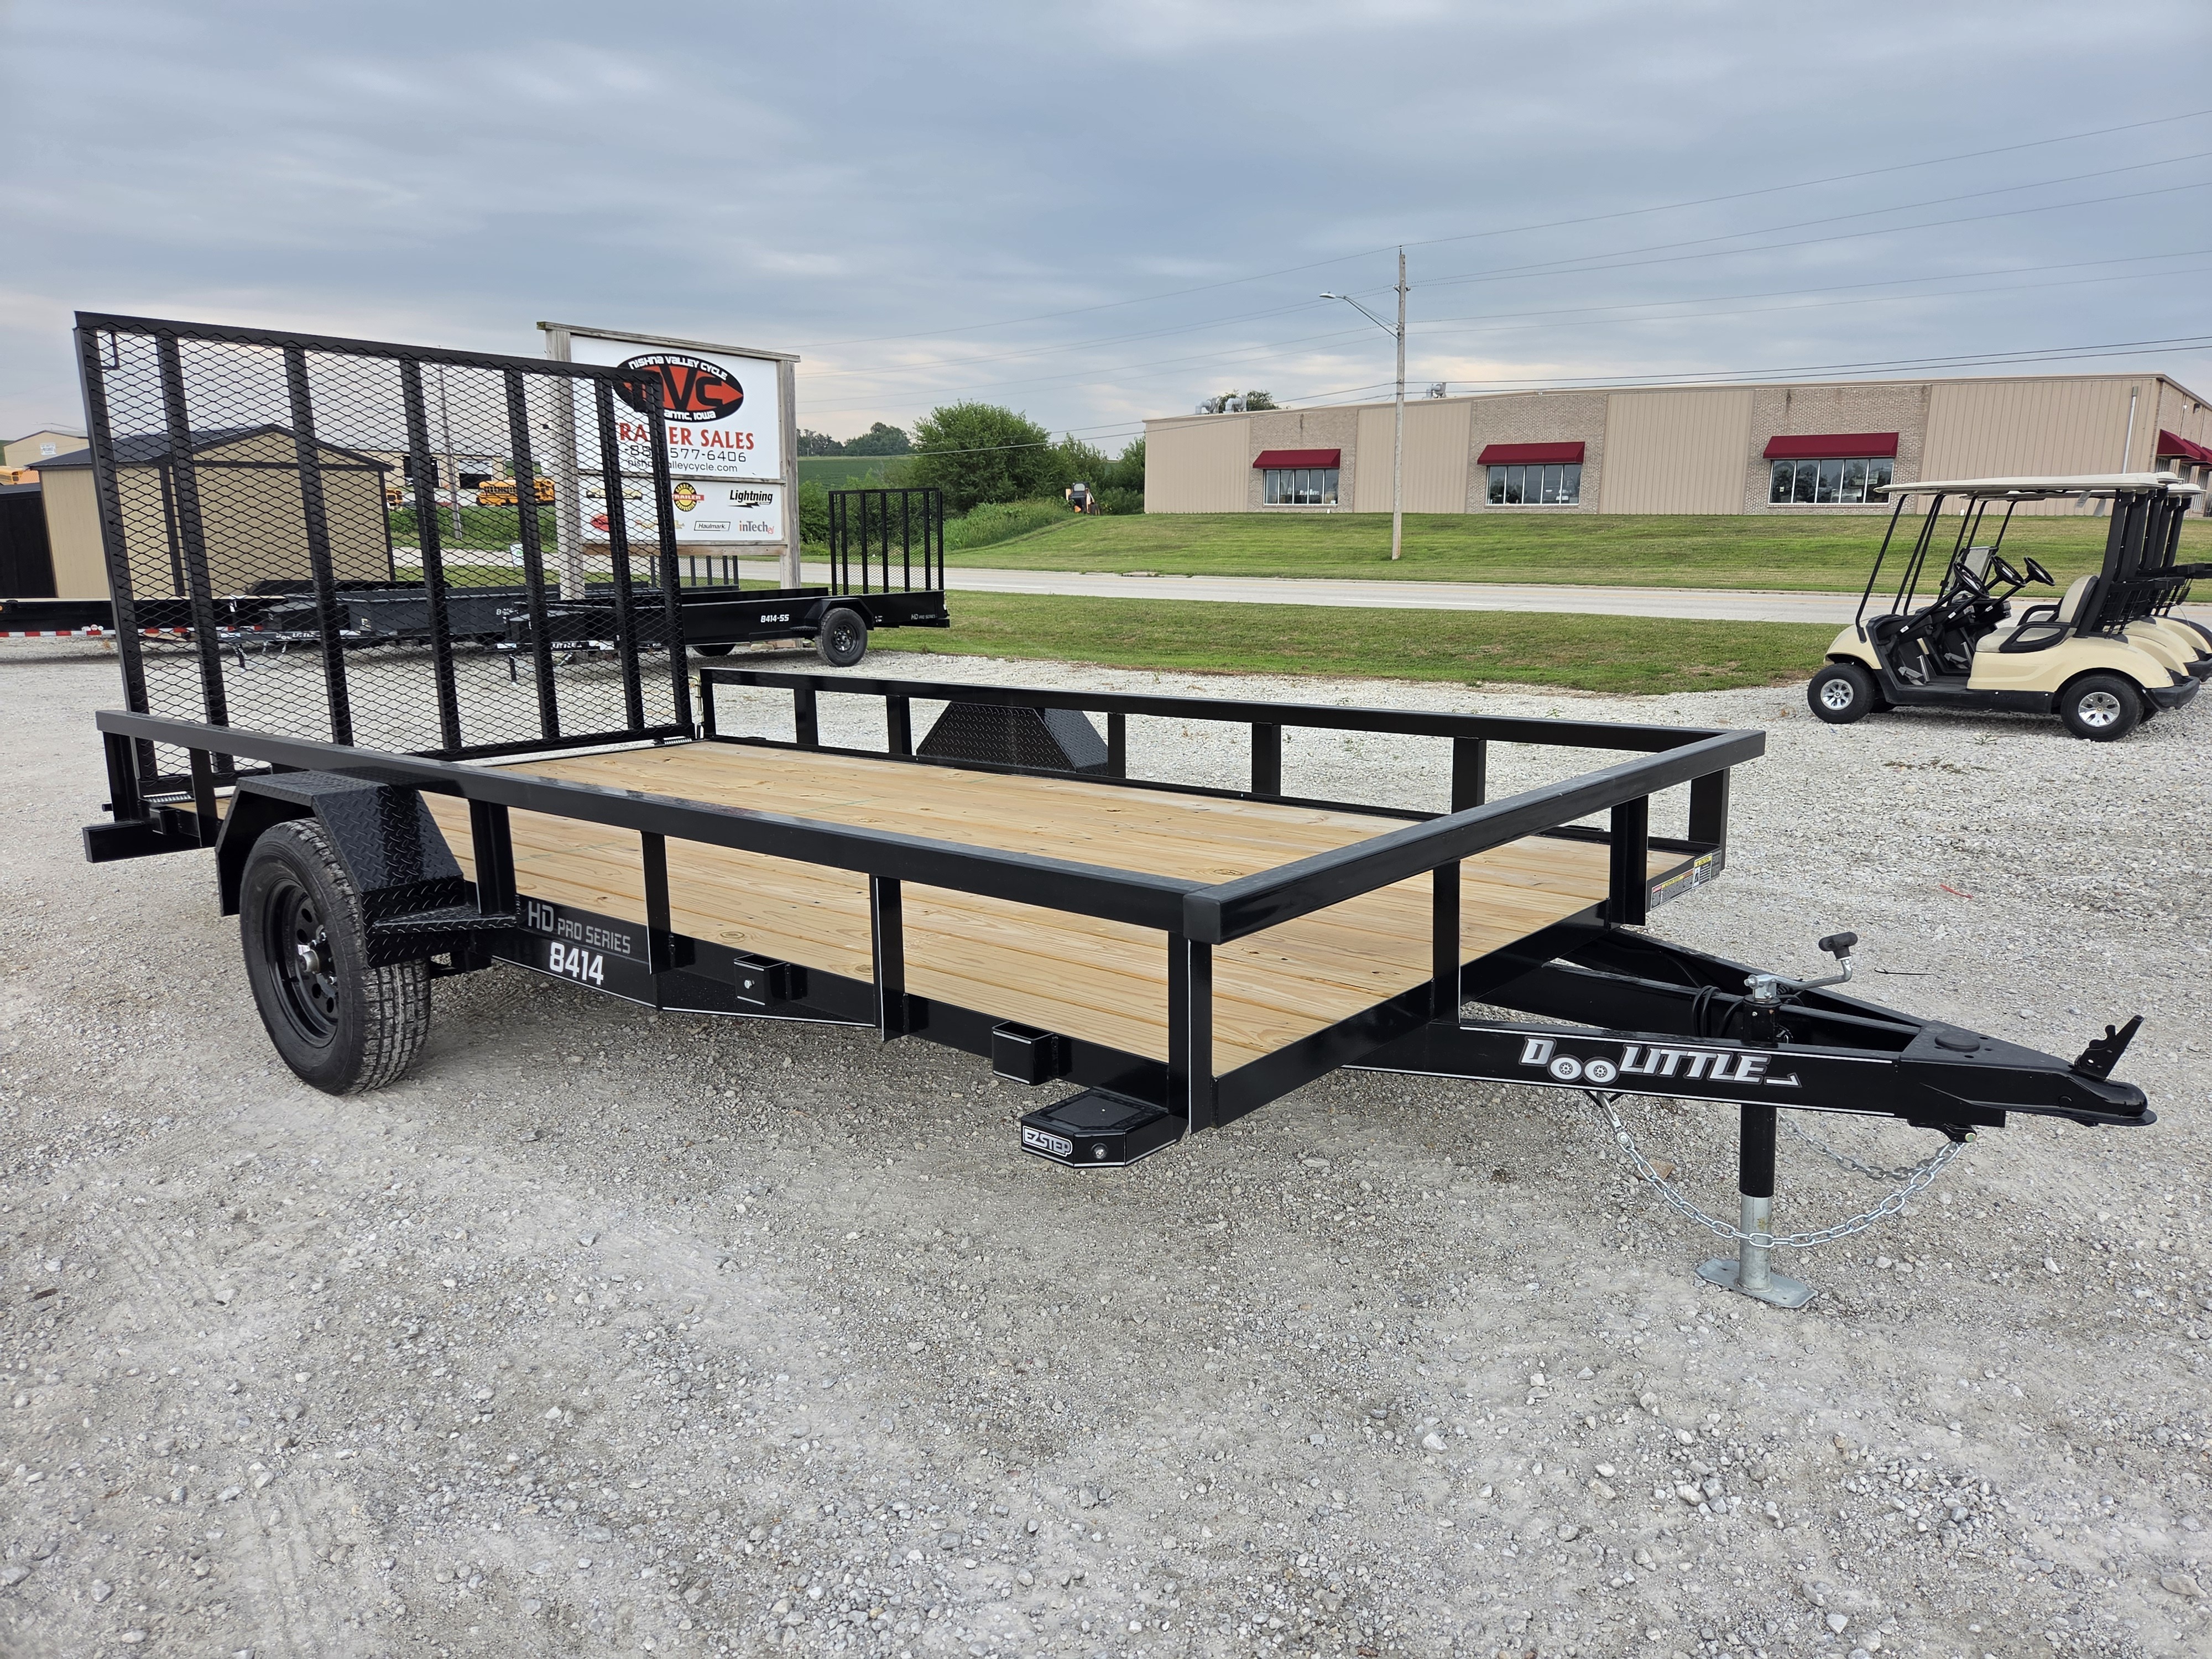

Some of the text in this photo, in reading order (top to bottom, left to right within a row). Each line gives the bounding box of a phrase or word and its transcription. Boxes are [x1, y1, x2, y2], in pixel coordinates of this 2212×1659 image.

[700, 363, 728, 380] CYCLE
[701, 429, 754, 450] SALES
[729, 489, 773, 505] Lightning
[739, 520, 768, 532] inTech
[528, 900, 631, 954] HD PRO SERIES
[550, 941, 604, 985] 8414
